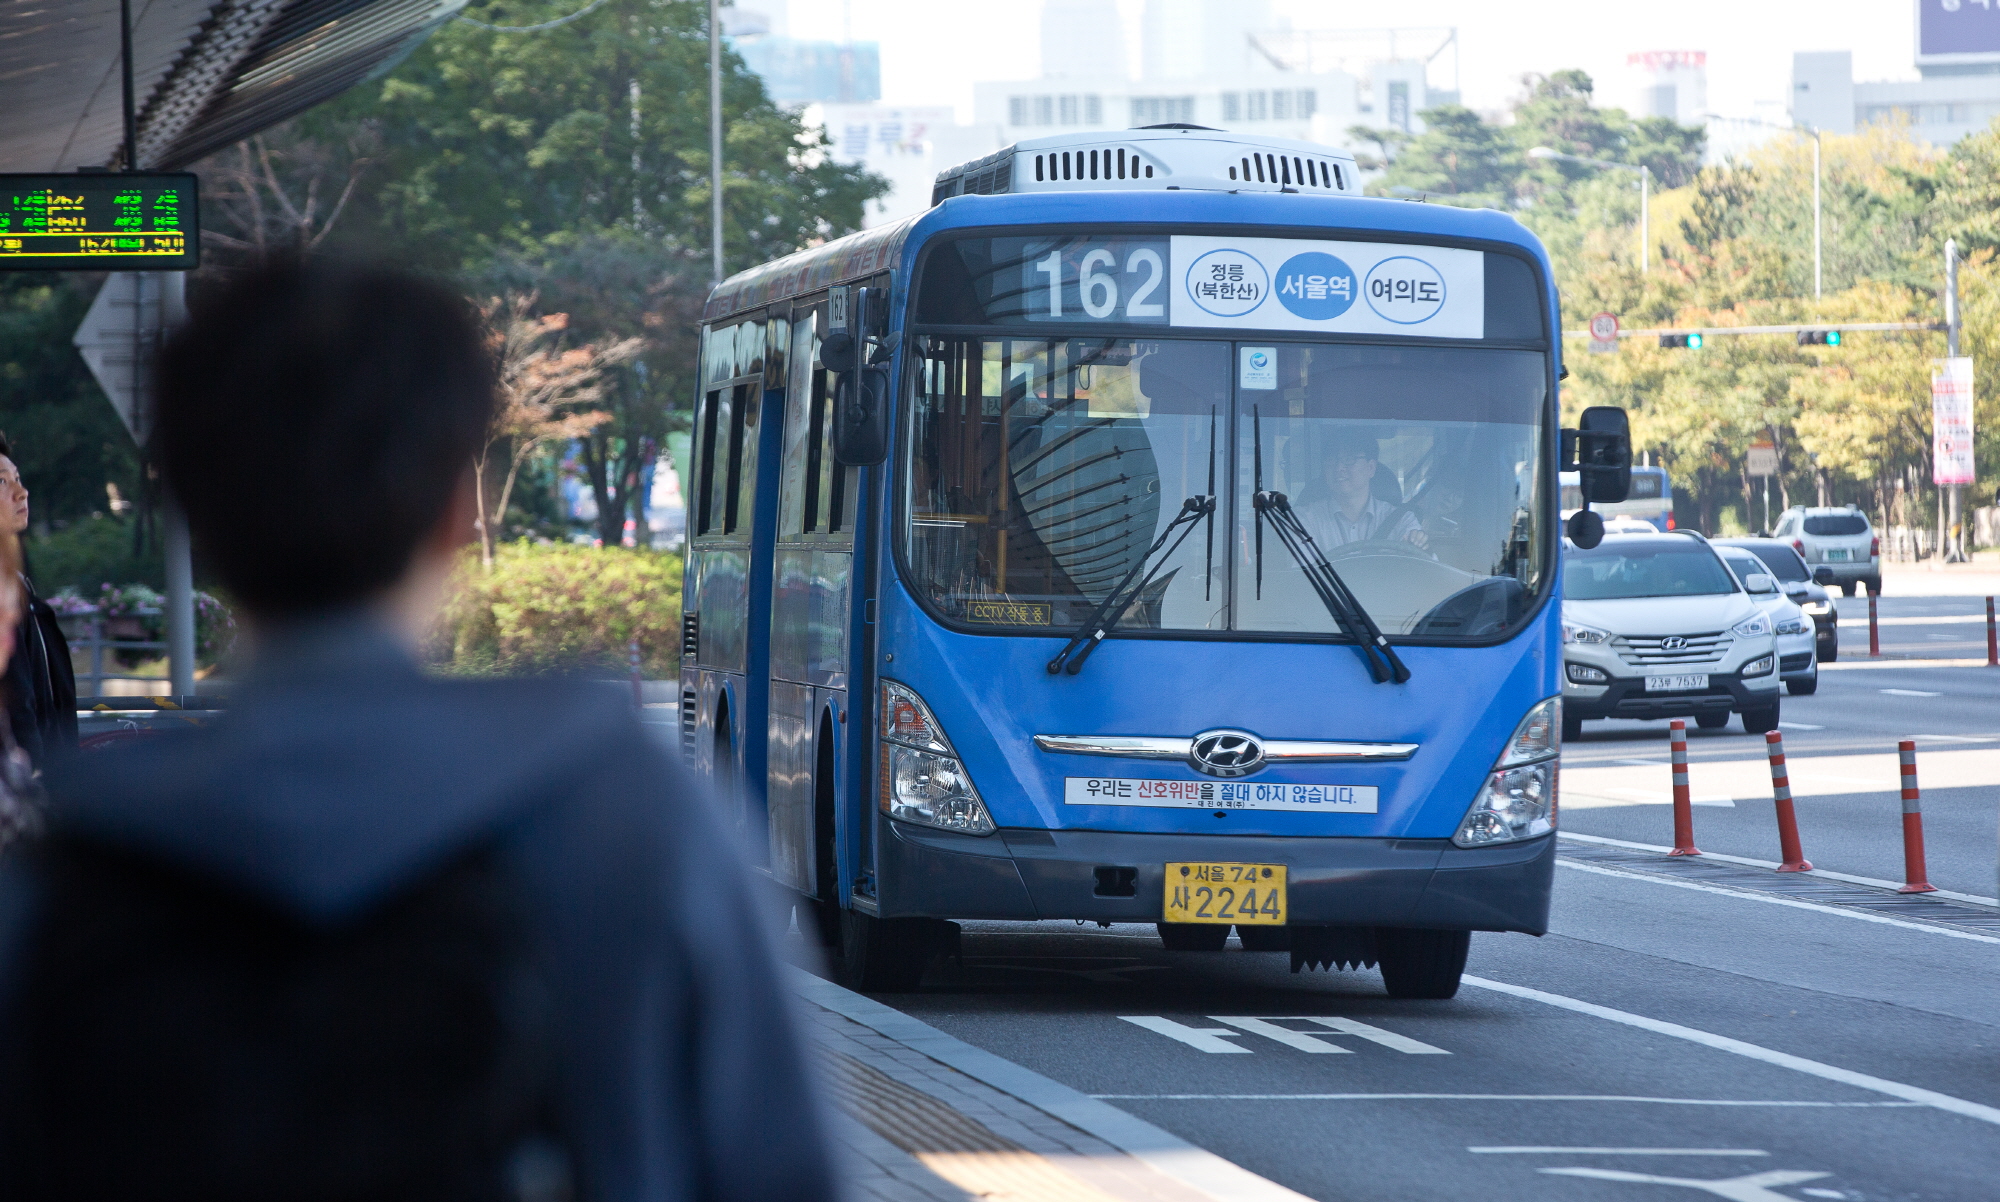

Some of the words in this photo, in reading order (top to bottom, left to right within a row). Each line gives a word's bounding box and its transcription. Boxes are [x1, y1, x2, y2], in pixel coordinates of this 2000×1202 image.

[1036, 248, 1164, 318] 162
[1210, 263, 1245, 282] 정릉
[1195, 282, 1260, 301] (북한산)
[1280, 274, 1351, 301] 서울역
[1371, 278, 1441, 303] 여의도
[831, 294, 843, 321] 162
[974, 605, 1005, 618] CCTV
[1006, 606, 1029, 621] 작동
[1086, 779, 1132, 798] 우리는
[1137, 781, 1215, 801] 신호위반을
[1220, 783, 1250, 802] 절대
[1256, 784, 1286, 803] 하지
[1292, 785, 1357, 804] 않습니다.
[1195, 865, 1225, 882] 서울
[1230, 866, 1257, 883] 74
